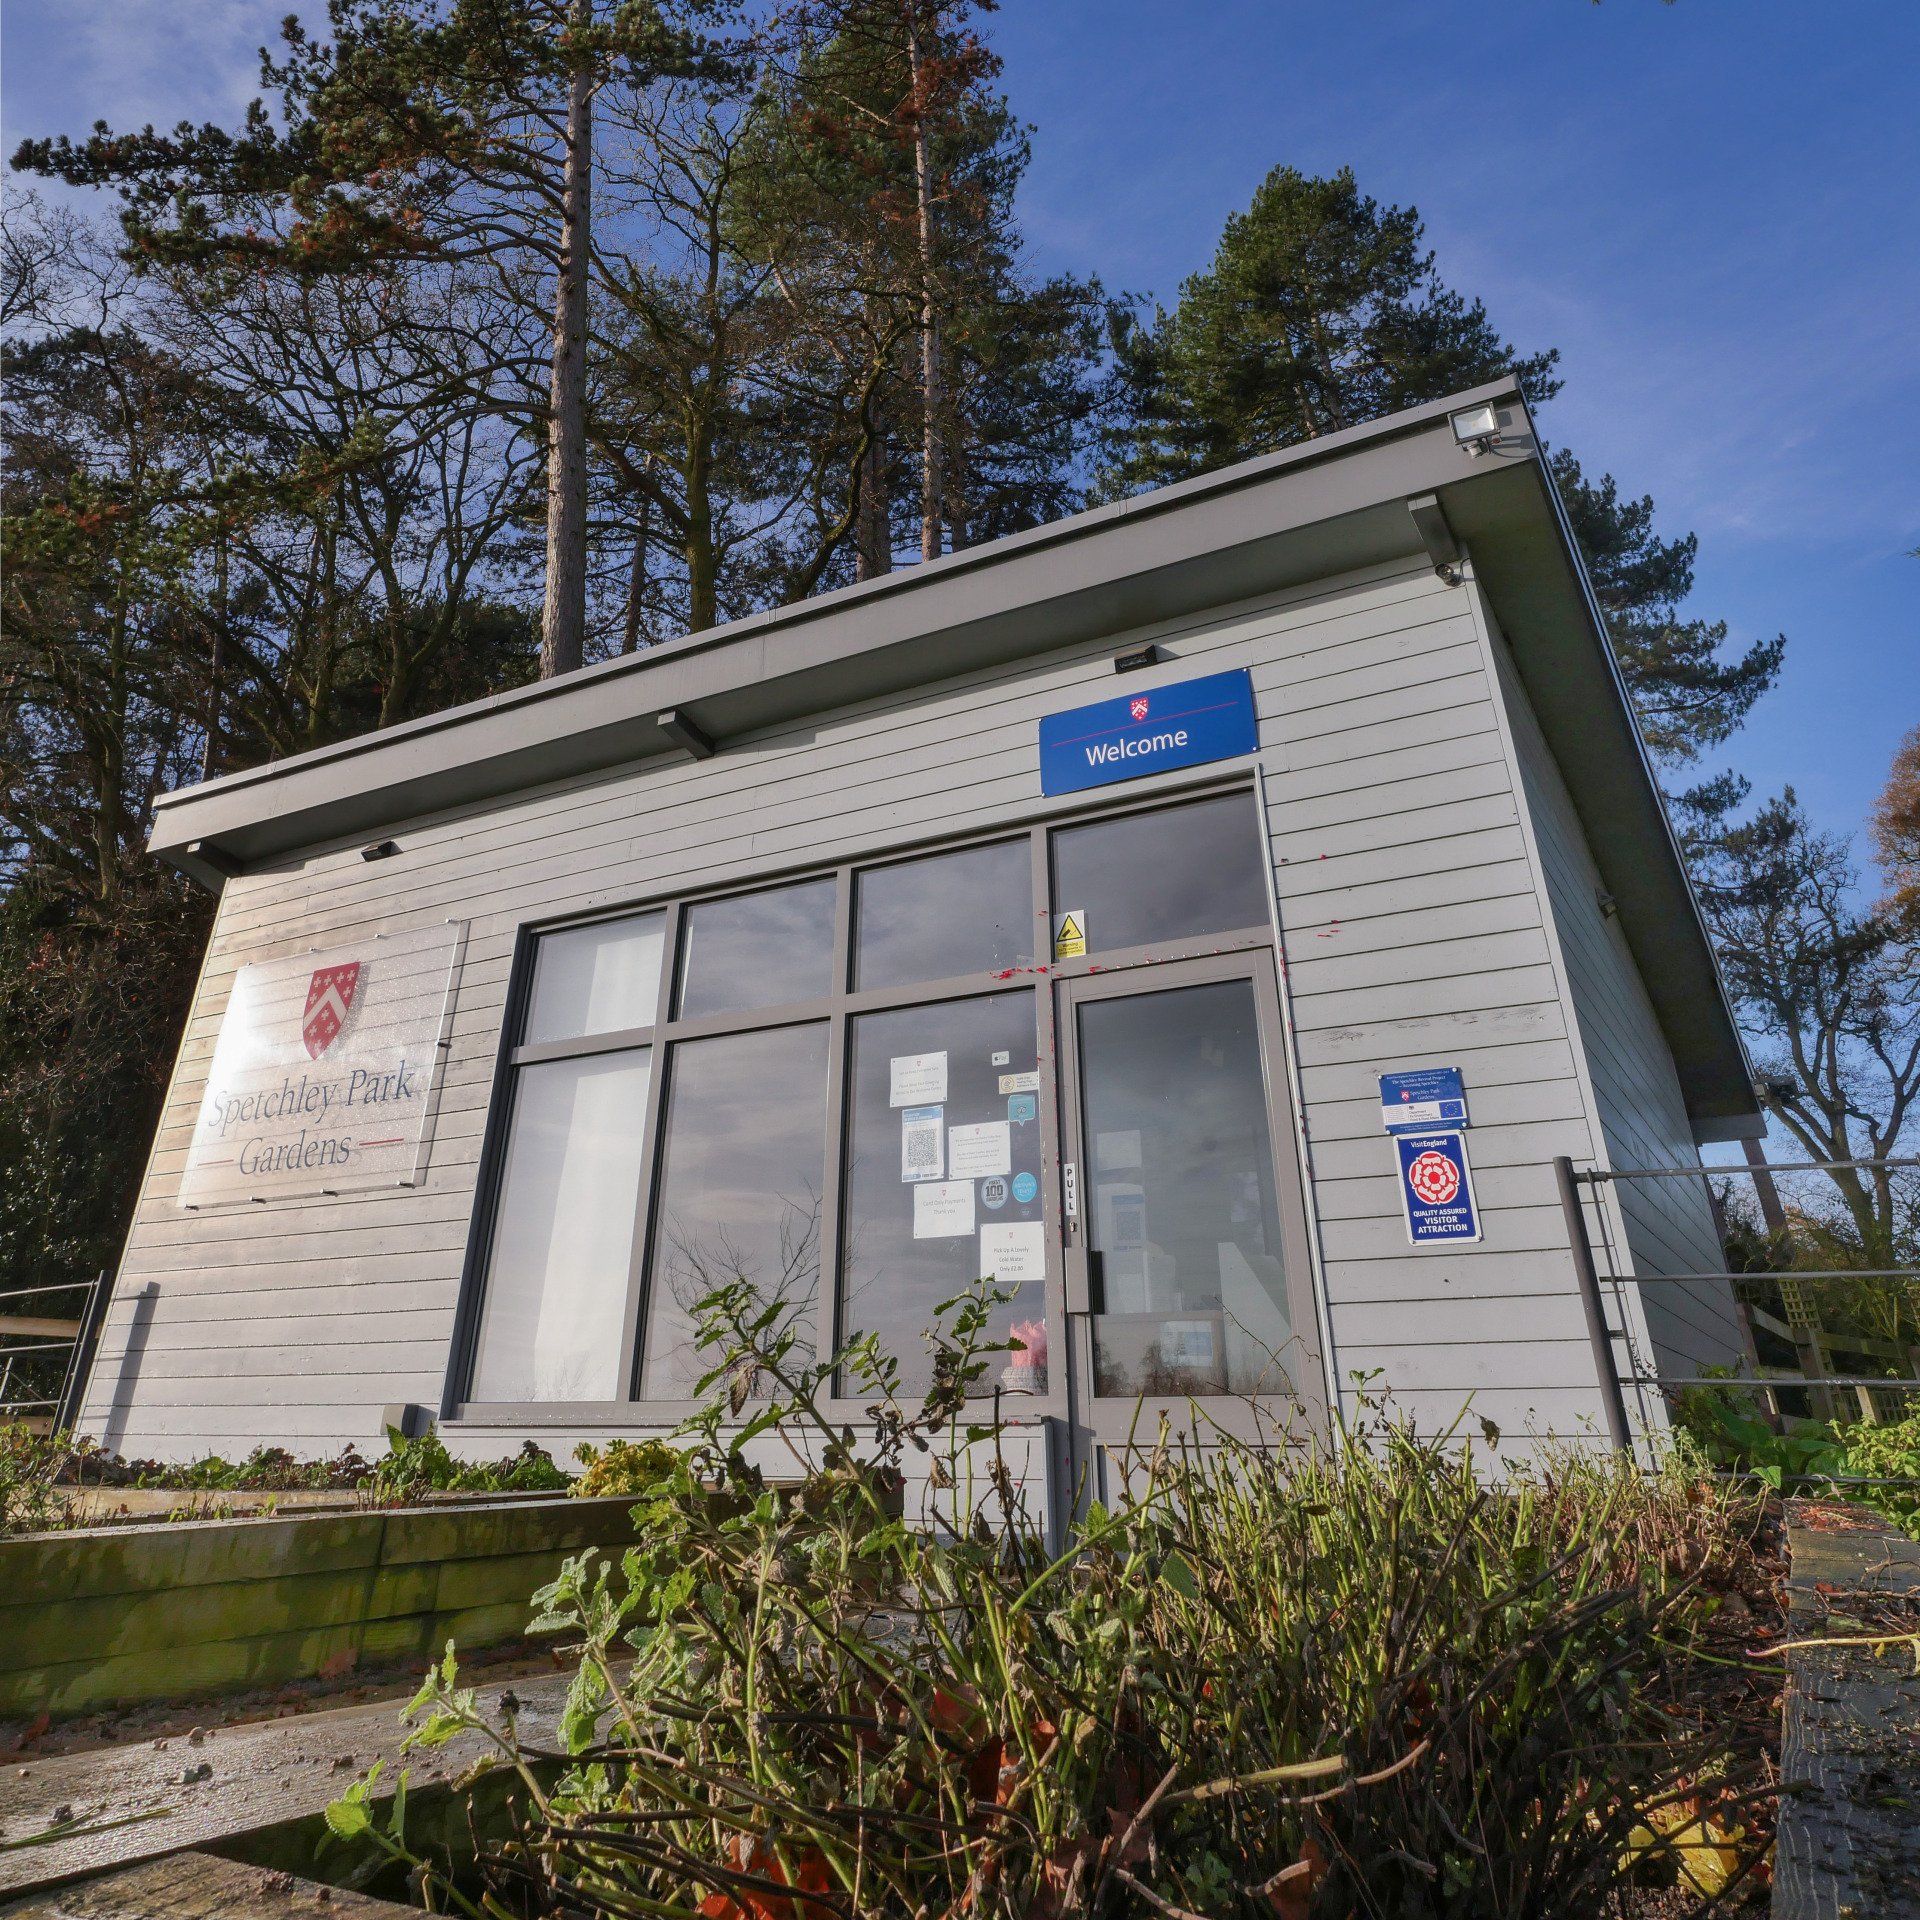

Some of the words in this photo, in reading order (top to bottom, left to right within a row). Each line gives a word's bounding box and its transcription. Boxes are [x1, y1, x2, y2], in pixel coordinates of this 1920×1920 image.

[1086, 730, 1188, 766] Welcome
[208, 1075, 338, 1137] Spetchley
[346, 1060, 416, 1107] Park
[1411, 1139, 1448, 1148] VisitEngland
[239, 1130, 352, 1176] Gardens
[985, 1184, 1003, 1197] 100
[1413, 1209, 1438, 1217] QUALITY
[1440, 1207, 1467, 1215] ASSURED
[1425, 1216, 1458, 1224] VISITOR
[1418, 1224, 1468, 1234] ATTRACTION
